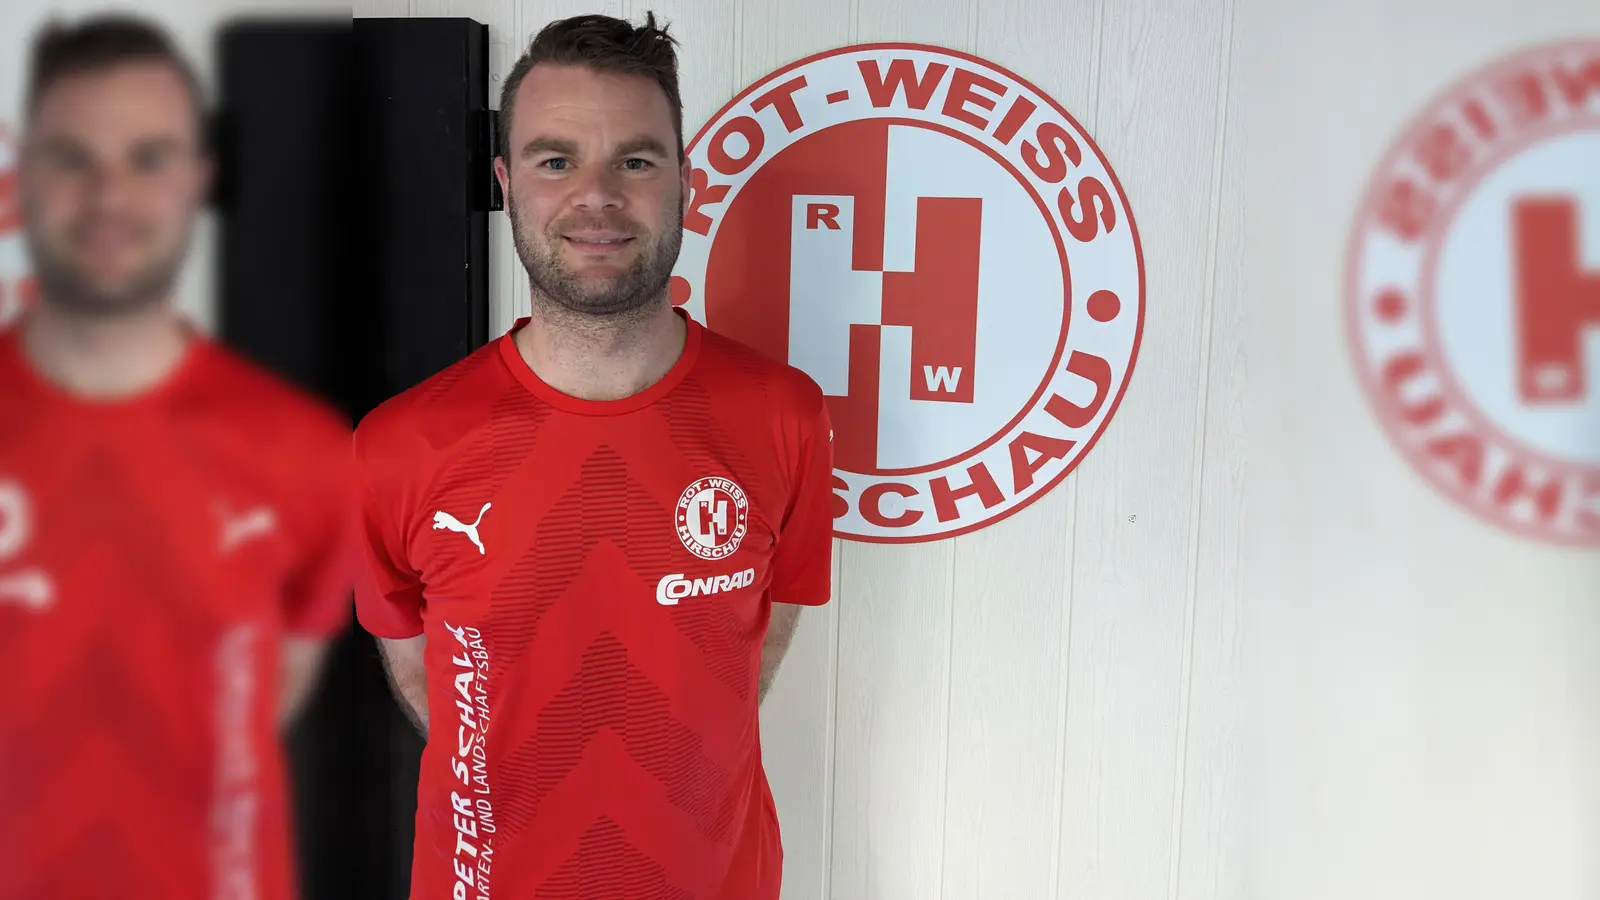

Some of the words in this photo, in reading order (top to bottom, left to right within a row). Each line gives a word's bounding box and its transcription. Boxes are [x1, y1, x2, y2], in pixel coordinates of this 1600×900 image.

[806, 203, 841, 230] R
[923, 366, 962, 393] W
[832, 350, 1112, 528] CHAU
[678, 524, 746, 558] HIRSCHAU
[656, 567, 755, 606] CONRAD
[465, 626, 490, 794] LANDSCHAFTSBAU
[476, 799, 496, 833] UND
[450, 791, 478, 900] PETER
